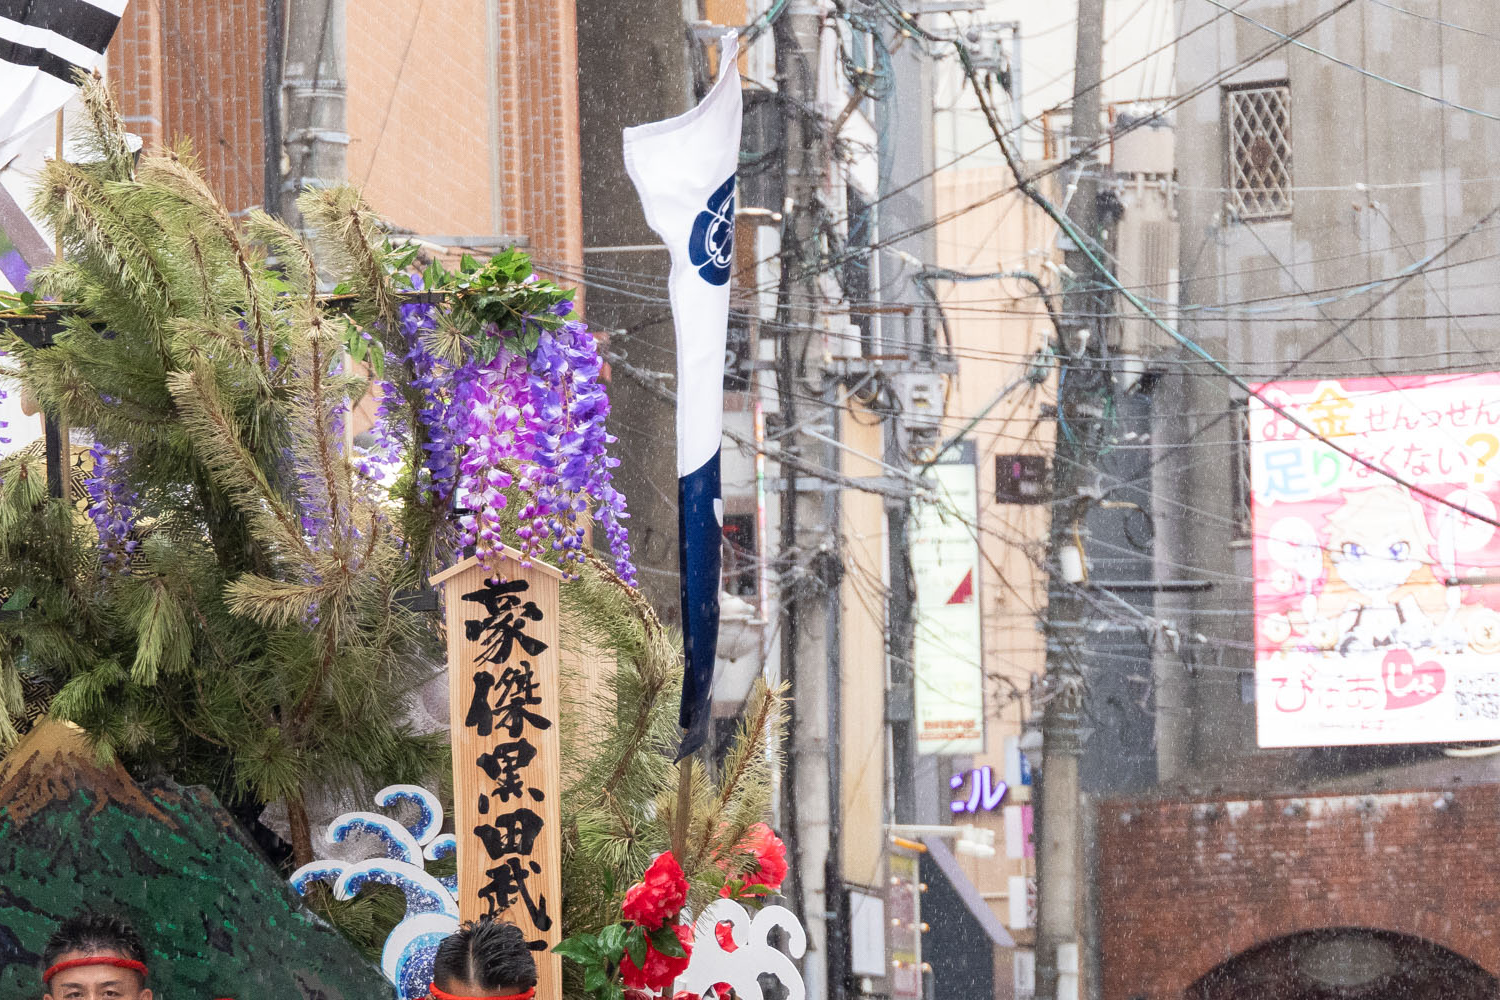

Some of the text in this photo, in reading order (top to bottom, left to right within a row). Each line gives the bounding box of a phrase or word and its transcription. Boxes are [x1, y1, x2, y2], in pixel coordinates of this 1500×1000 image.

[461, 578, 553, 952] 豪傑黒田武
